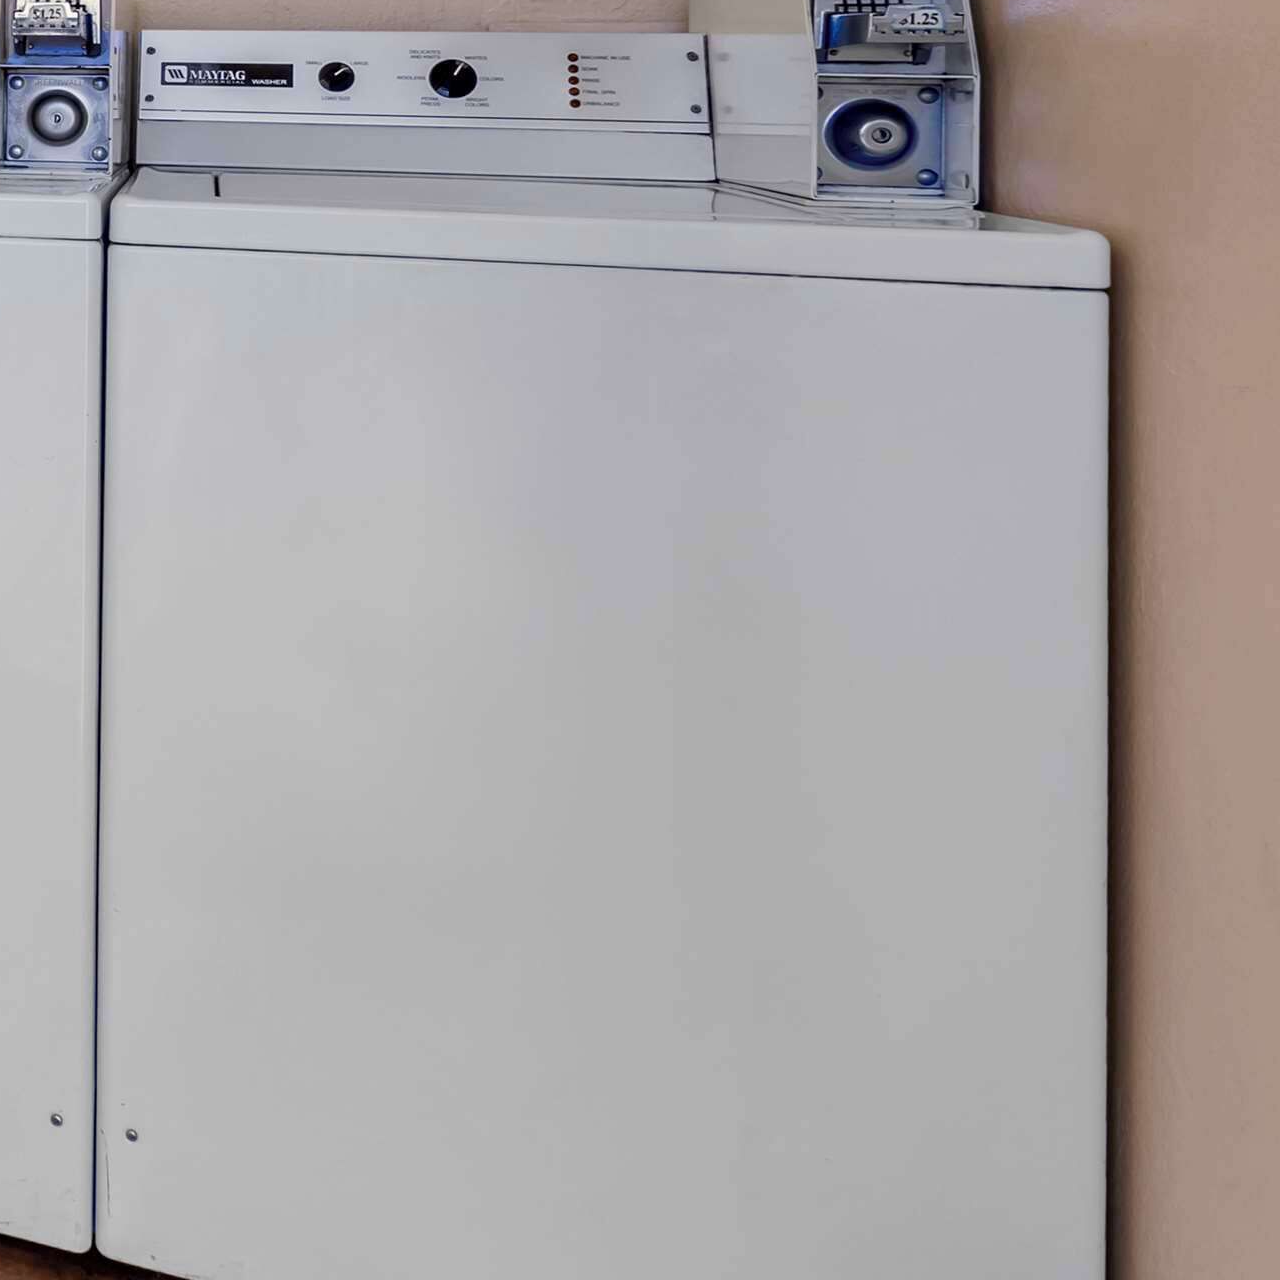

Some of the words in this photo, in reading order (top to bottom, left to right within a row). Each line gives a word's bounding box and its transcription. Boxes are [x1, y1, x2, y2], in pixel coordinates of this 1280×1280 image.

[32, 8, 62, 20] $1.25
[189, 70, 246, 81] MAYTAG
[251, 78, 288, 86] WASHER
